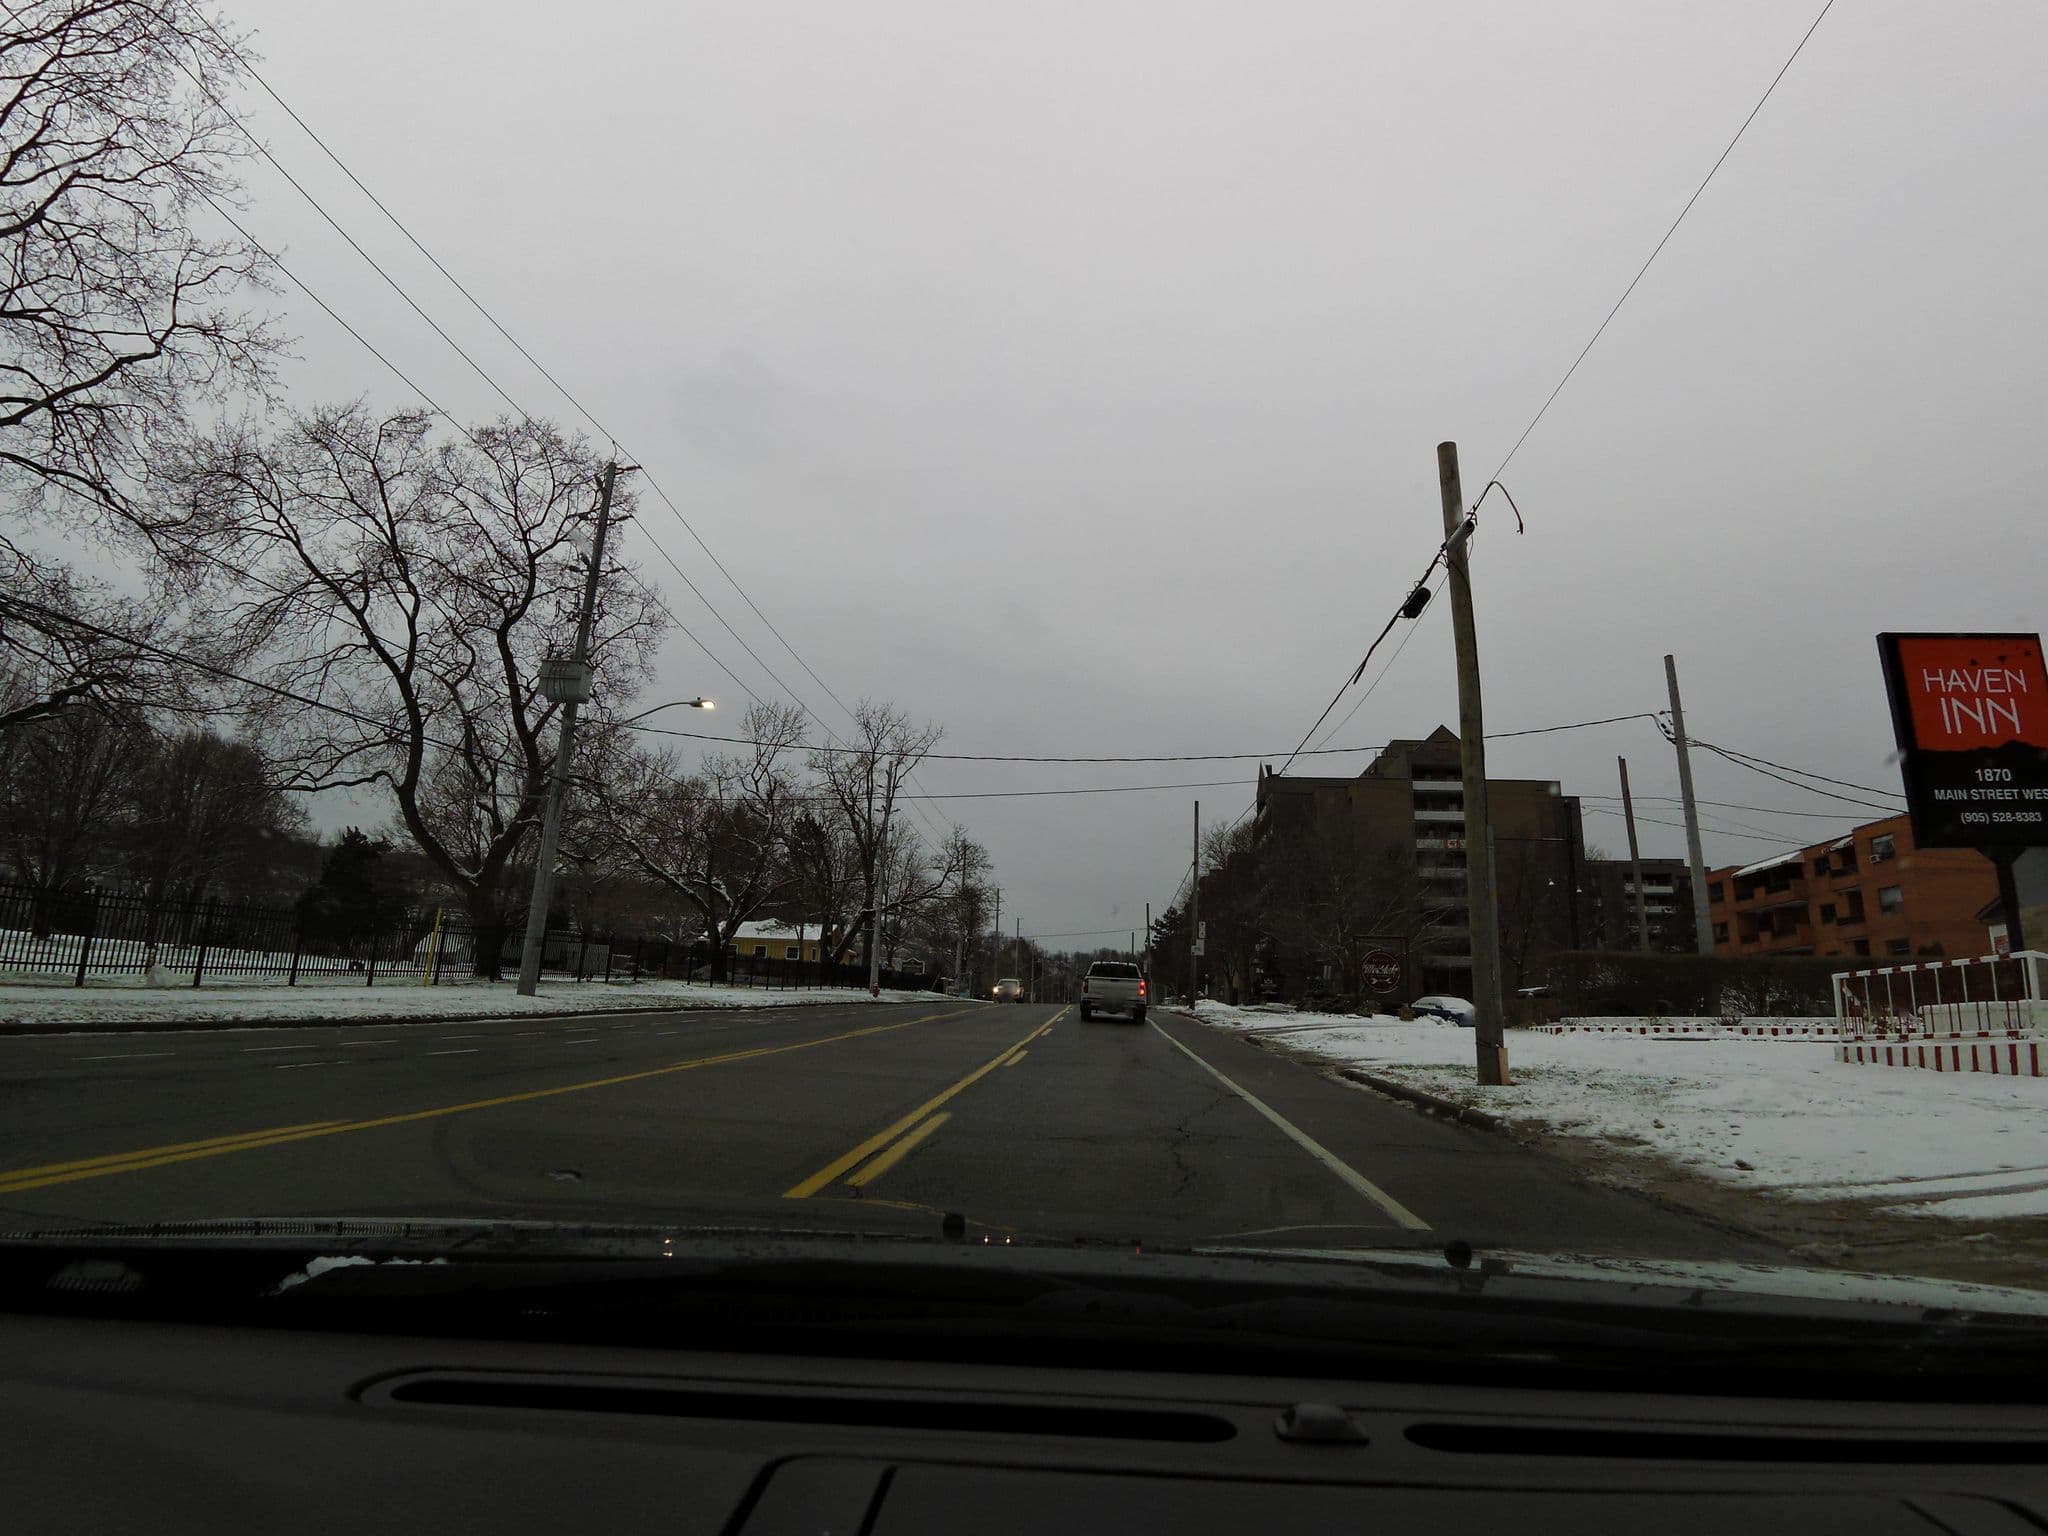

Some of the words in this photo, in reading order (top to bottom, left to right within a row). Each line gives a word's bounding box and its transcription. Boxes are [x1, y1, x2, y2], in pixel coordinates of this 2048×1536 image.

[1922, 668, 2028, 693] HAVEN
[1940, 697, 2021, 735] INN
[1974, 768, 2012, 782] 1870
[1933, 788, 1968, 800] MAIN
[1970, 788, 2019, 800] STREET
[1960, 812, 1990, 824] (905)
[1992, 811, 2042, 823] 528-8383
